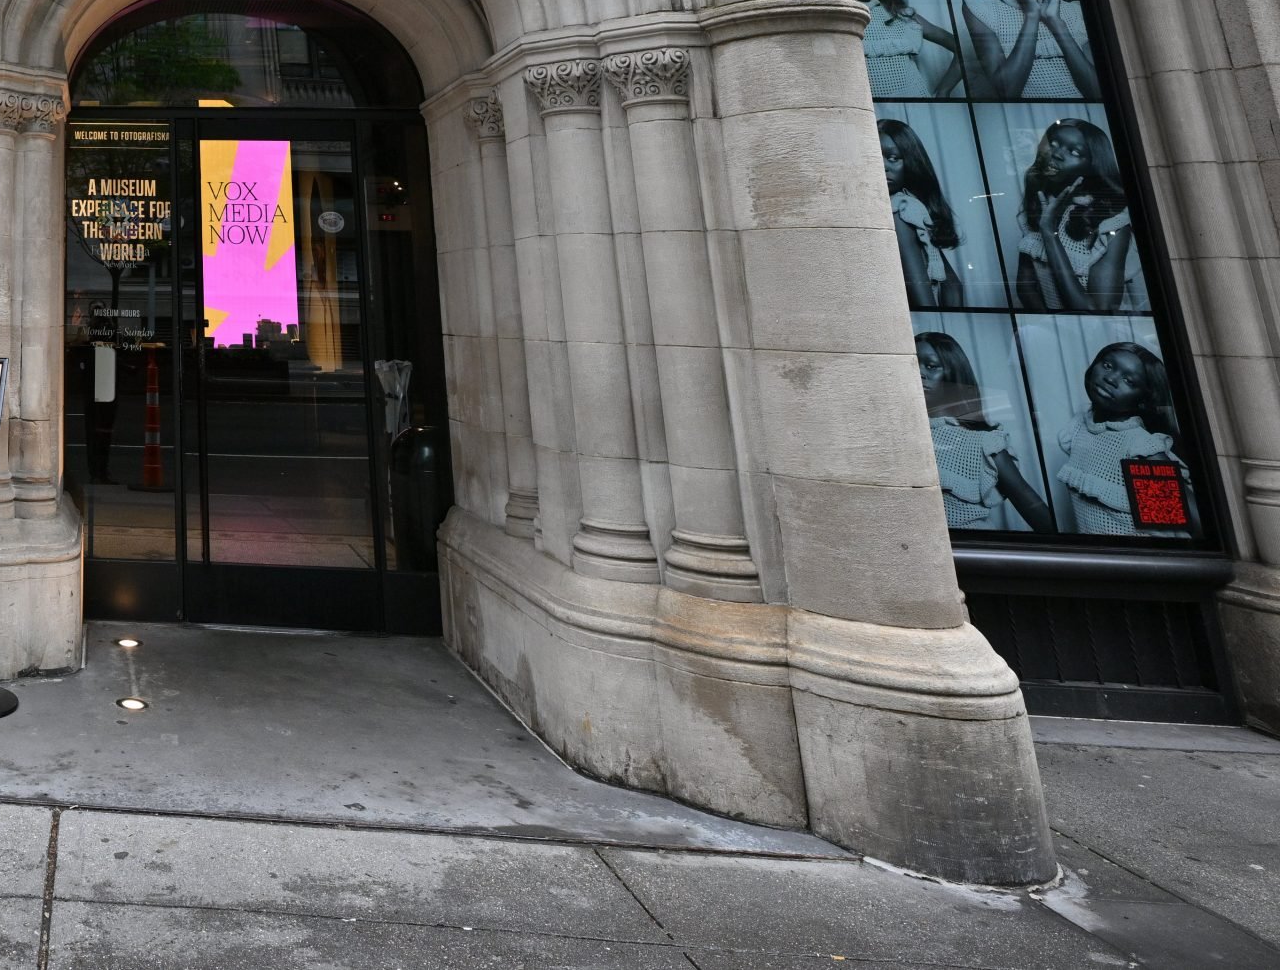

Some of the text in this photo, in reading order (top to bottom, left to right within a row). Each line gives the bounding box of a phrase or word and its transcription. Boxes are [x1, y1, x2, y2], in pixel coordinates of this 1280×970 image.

[74, 131, 170, 141] WELCOME TO FOTOGRAFISKA
[88, 179, 156, 196] A MUSEUM
[207, 181, 258, 201] VOX
[208, 203, 288, 223] MEDIA
[209, 225, 268, 245] NOW
[100, 243, 145, 261] WORLD
[93, 309, 140, 317] MUSEUM HOURS
[82, 326, 115, 339] Monday
[123, 327, 155, 340] Sunday
[1129, 464, 1176, 476] READ MORE
